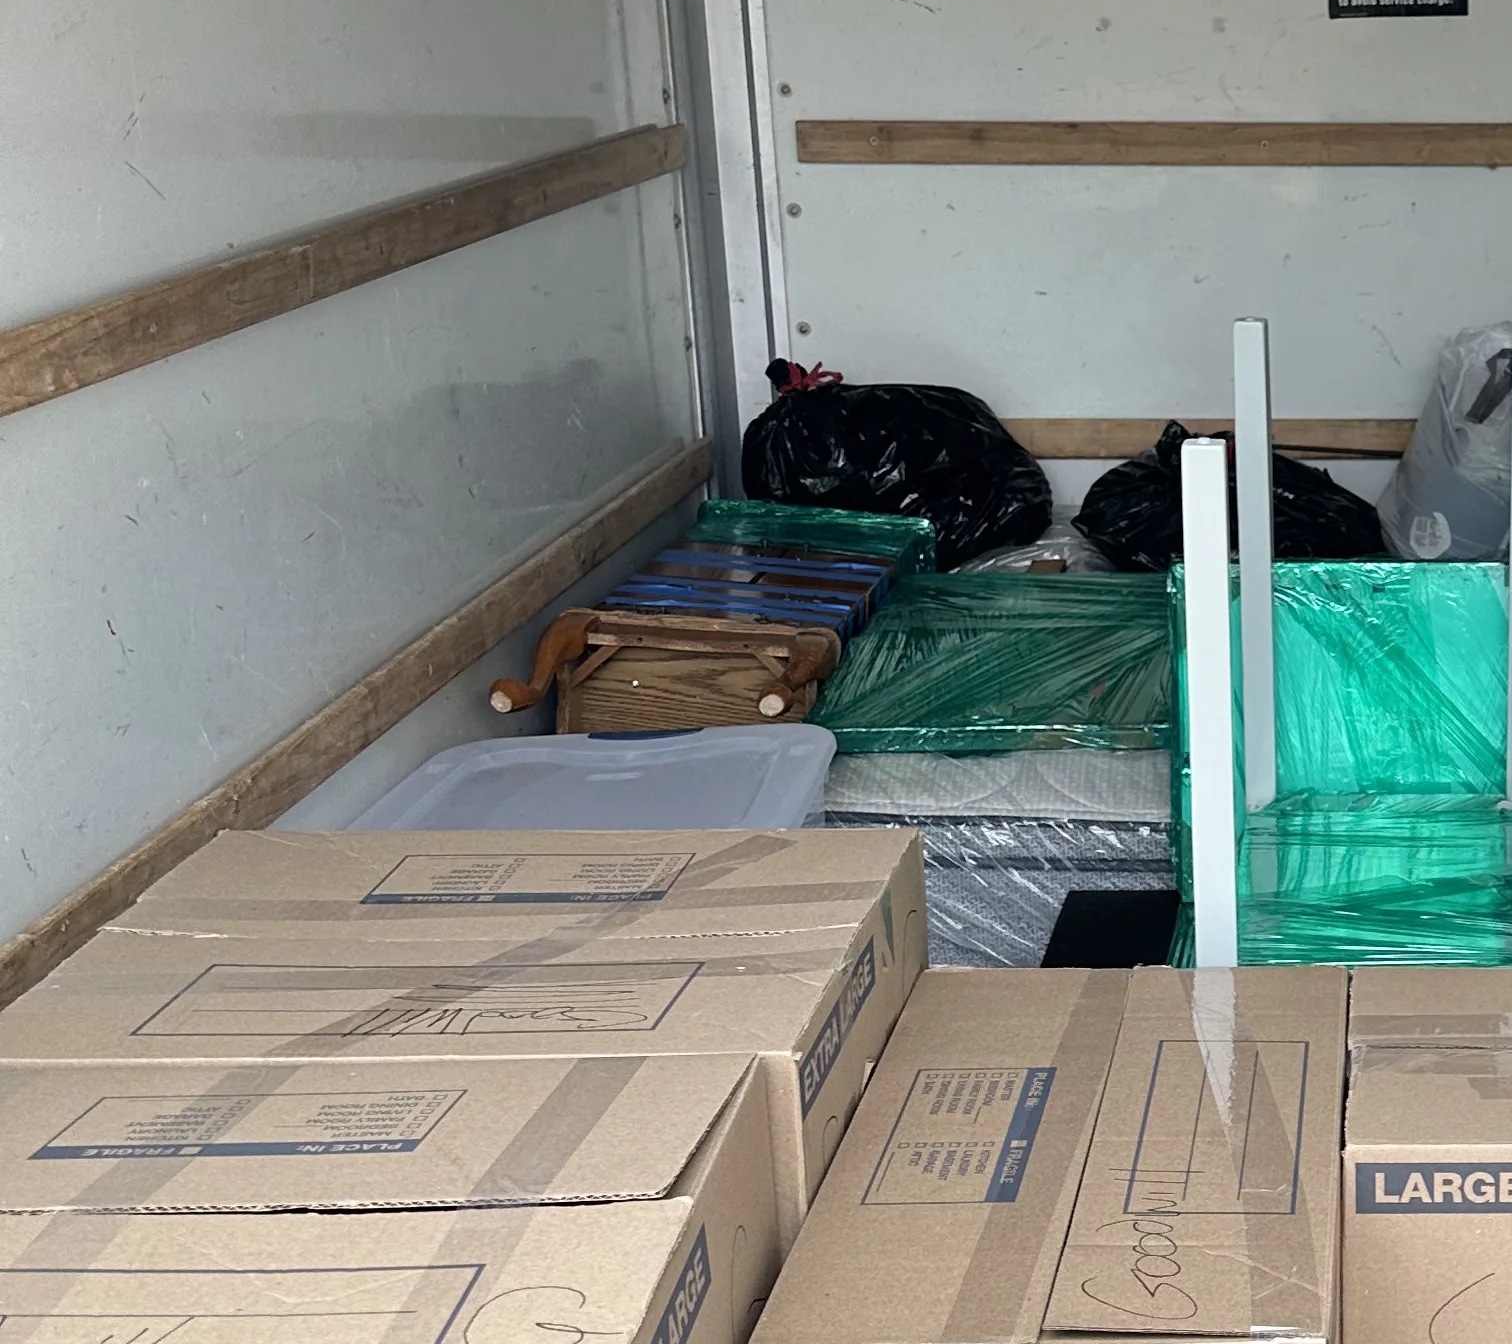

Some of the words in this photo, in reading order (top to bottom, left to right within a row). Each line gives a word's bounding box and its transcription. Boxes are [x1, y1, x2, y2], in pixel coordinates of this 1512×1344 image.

[803, 1022, 840, 1105] EXTRA
[840, 951, 873, 1033] LARGE
[1028, 1072, 1048, 1097] PLACE
[323, 1123, 399, 1132] BEDROOM
[124, 1134, 190, 1142] KITCHEN
[331, 1130, 394, 1139] MASTER
[83, 1146, 175, 1156] FRAGILE
[297, 1143, 325, 1153] IN:
[330, 1142, 402, 1153] PLACE
[1000, 1147, 1024, 1185] FRAGILE
